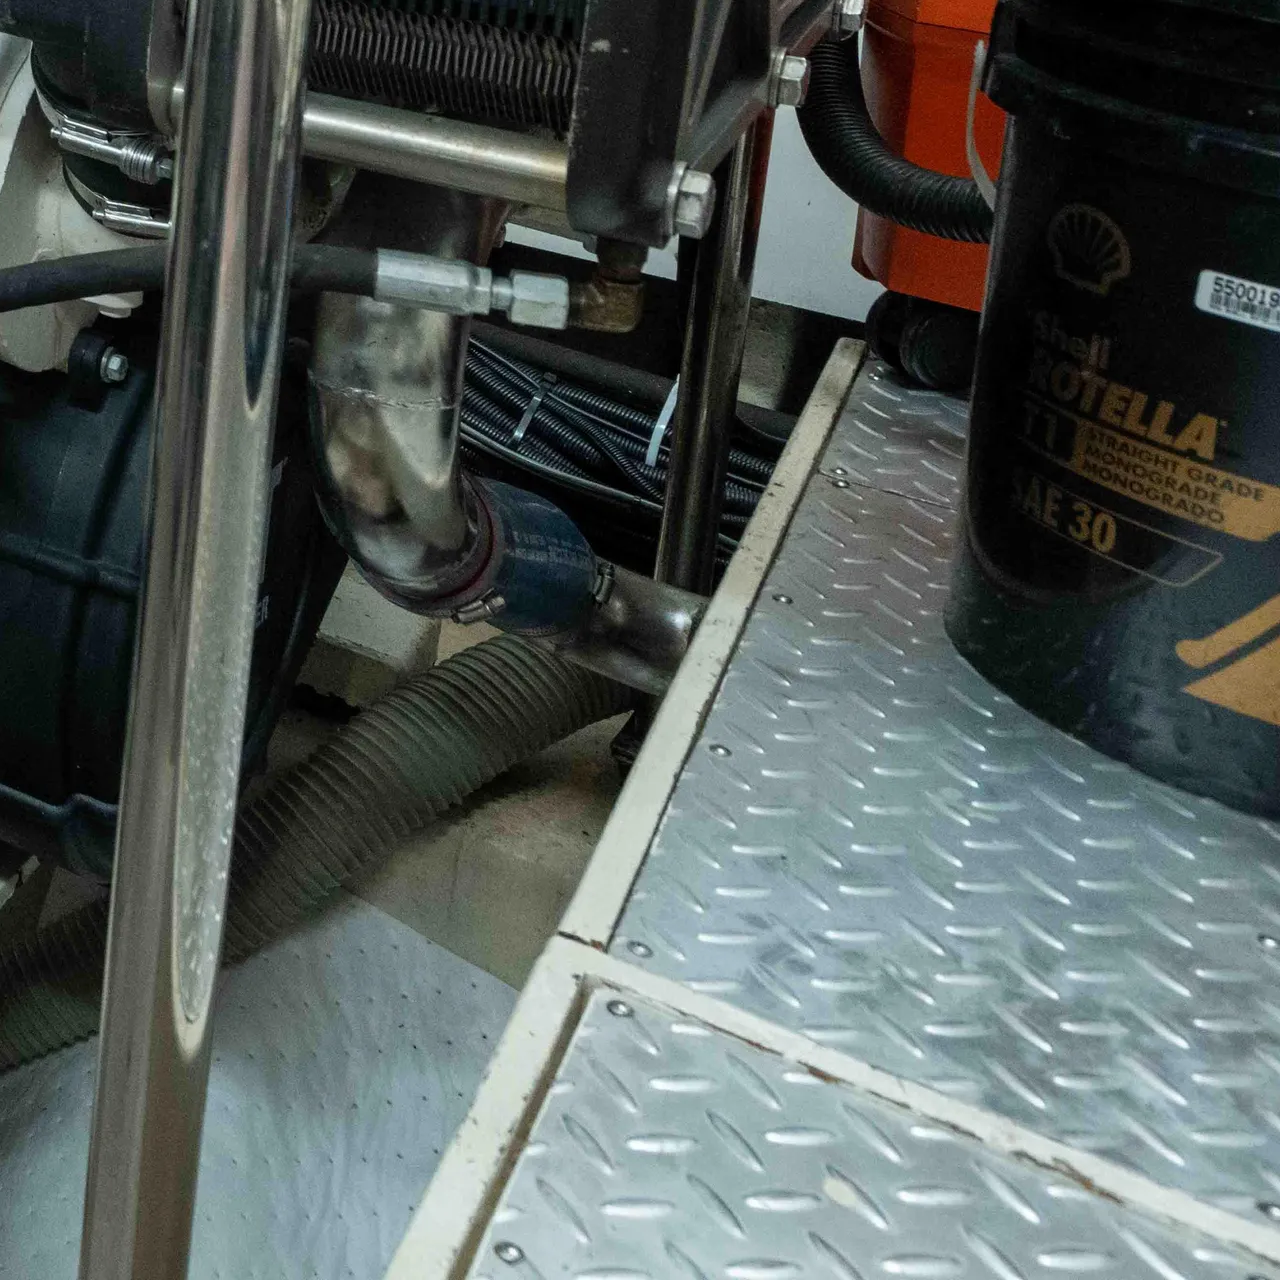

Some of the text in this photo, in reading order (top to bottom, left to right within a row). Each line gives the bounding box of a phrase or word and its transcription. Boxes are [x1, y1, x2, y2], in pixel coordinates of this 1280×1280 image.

[1034, 309, 1110, 370] Shell
[1028, 345, 1218, 461] ROTELLA
[1085, 458, 1225, 524] MONOGRADO
[1086, 426, 1266, 503] STRAIGHT GRADE
[1086, 442, 1222, 504] MONOGRADE
[1068, 504, 1116, 553] 30
